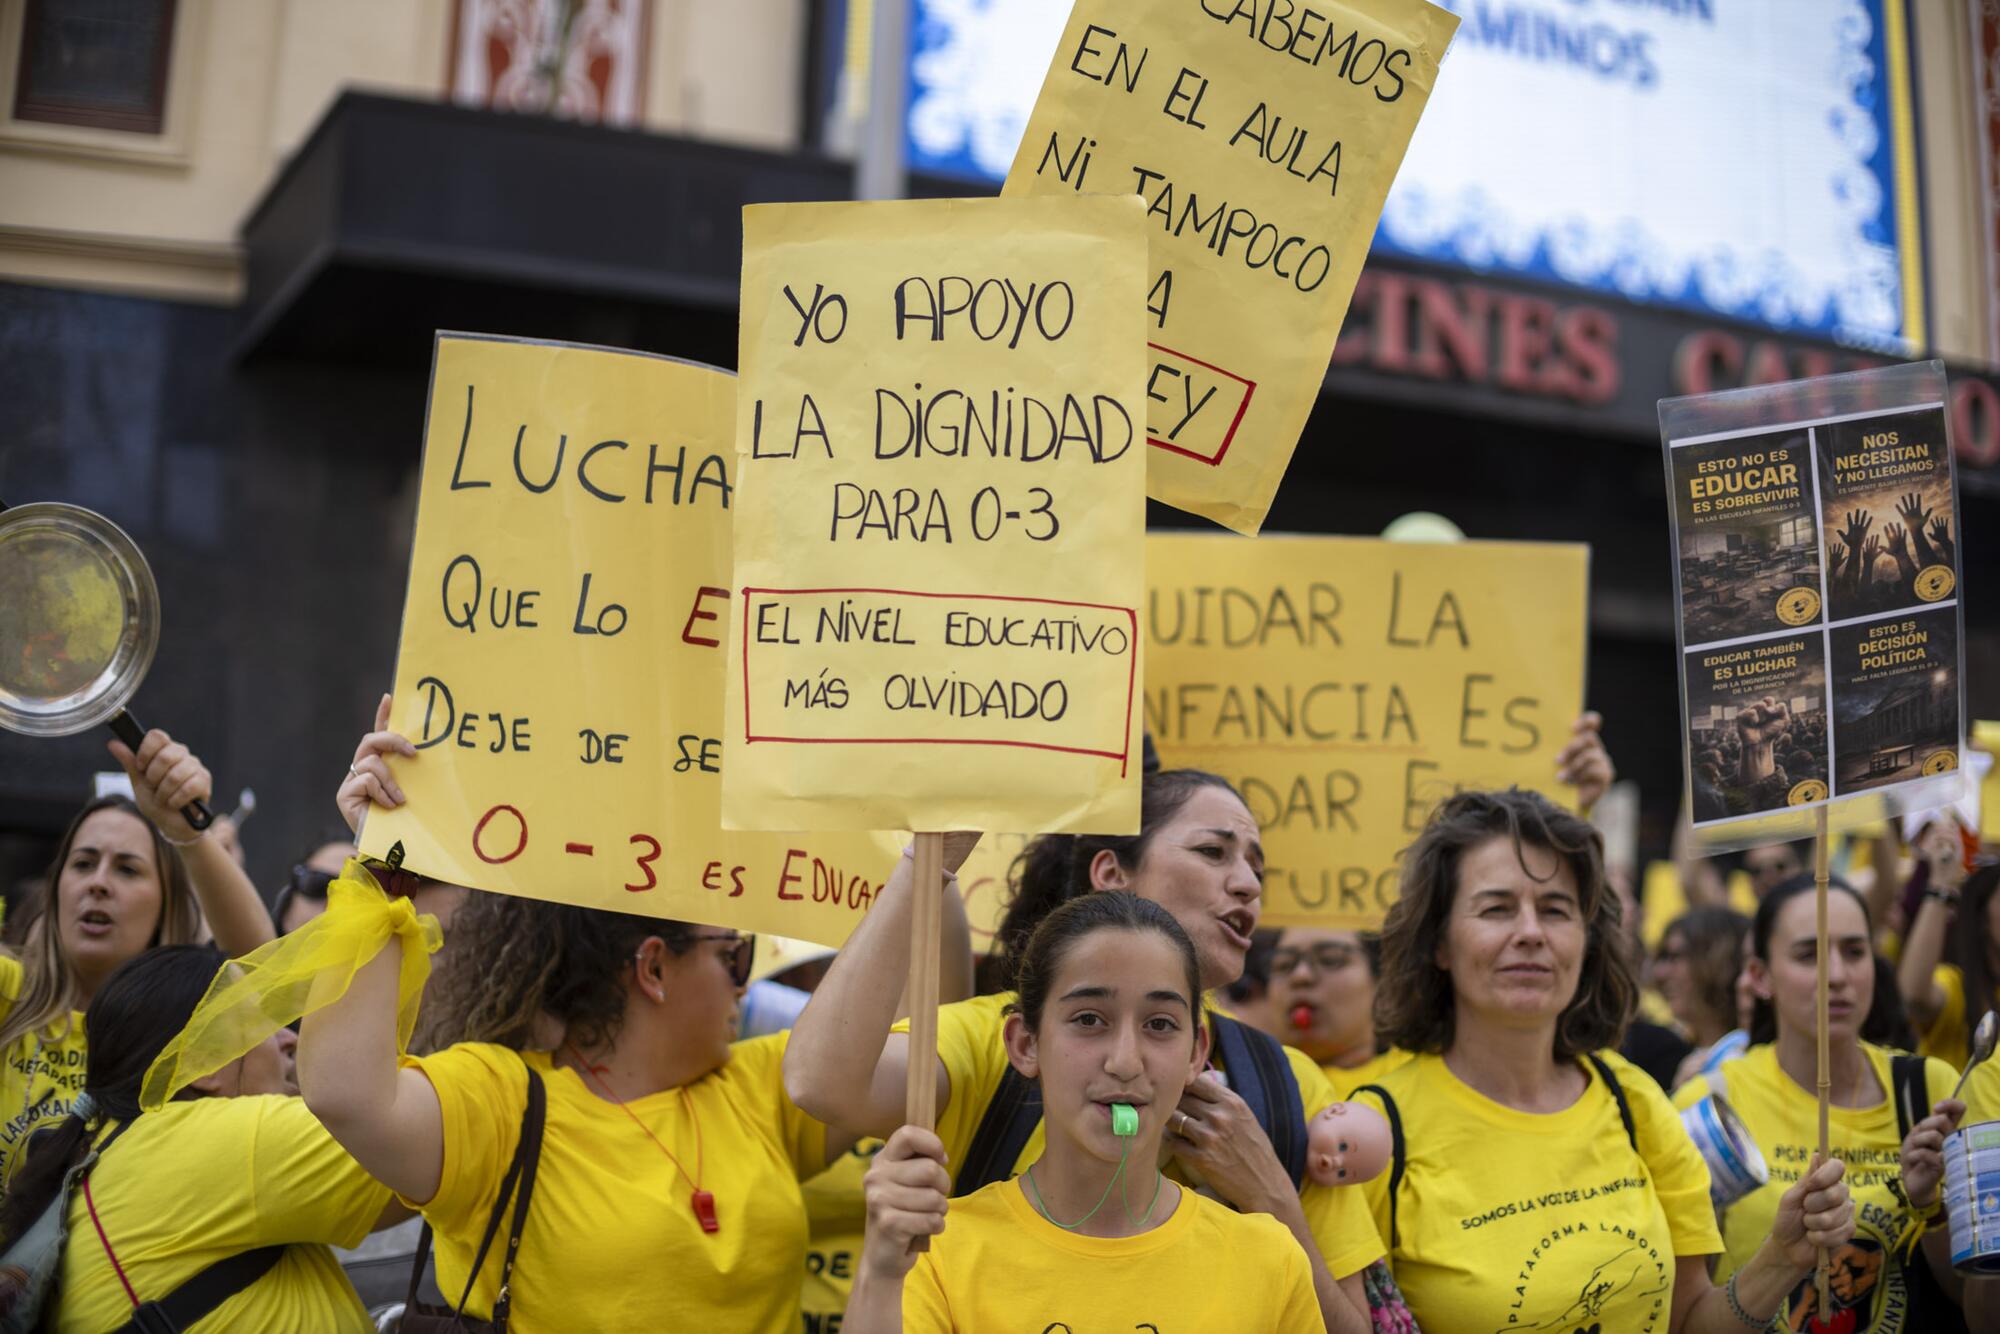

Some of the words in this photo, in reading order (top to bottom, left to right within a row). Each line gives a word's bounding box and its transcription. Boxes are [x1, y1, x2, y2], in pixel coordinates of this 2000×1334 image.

[1071, 24, 1148, 94] EN
[1163, 67, 1209, 130] EL
[1229, 102, 1341, 197] AULA
[1133, 166, 1331, 293] TAMPOCO
[783, 283, 848, 347] YO
[895, 276, 1074, 348] APOYO
[1147, 363, 1217, 440] EY
[450, 385, 734, 510] LUCHA
[753, 394, 834, 460] LA
[1862, 431, 1899, 450] NOS
[1697, 457, 1737, 474] ESTO
[1742, 453, 1765, 467] NO
[1769, 449, 1789, 463] ES
[1834, 472, 1844, 485] Y
[1846, 470, 1866, 483] NO
[1869, 459, 1934, 480] LLEGAMOS
[1835, 443, 1929, 471] NECESITAN
[1689, 463, 1799, 499] EDUCAR
[1693, 501, 1711, 514] ES
[1715, 486, 1800, 511] SOBREVIVIR
[830, 483, 952, 543] PARA
[971, 486, 1060, 541] 0-3
[1705, 513, 1718, 523] LAS
[1719, 509, 1752, 521] ESCUELAS
[442, 554, 541, 633] QUE
[573, 573, 628, 636] LO
[682, 586, 731, 648] E
[1149, 582, 1345, 650] UIDAR
[1386, 570, 1470, 649] LA
[757, 602, 800, 645] EL
[1859, 630, 1928, 656] DECISIÓN
[1869, 624, 1898, 639] ESTO
[1902, 620, 1917, 632] ES
[1703, 651, 1751, 668] EDUCAR
[1752, 640, 1805, 659] TAMBIÉN
[1714, 667, 1733, 681] ES
[1736, 656, 1798, 677] LUCHAR
[1861, 647, 1927, 671] POLÍTICA
[784, 668, 849, 709] MÁS
[1730, 680, 1740, 688] LA
[414, 676, 531, 753] DEJE
[579, 728, 629, 764] DE
[673, 735, 723, 774] SE
[1144, 682, 1420, 743] NFANCIA
[1459, 673, 1542, 755] ES
[1240, 768, 1361, 833] DAR
[702, 861, 746, 898] ES
[1461, 1203, 1517, 1230] SOMOS
[1519, 1199, 1536, 1212] LA
[1536, 1193, 1563, 1209] VOZ
[1564, 1190, 1581, 1203] DE
[1582, 1187, 1600, 1200] LA
[1508, 1222, 1590, 1323] PLATAFORMA
